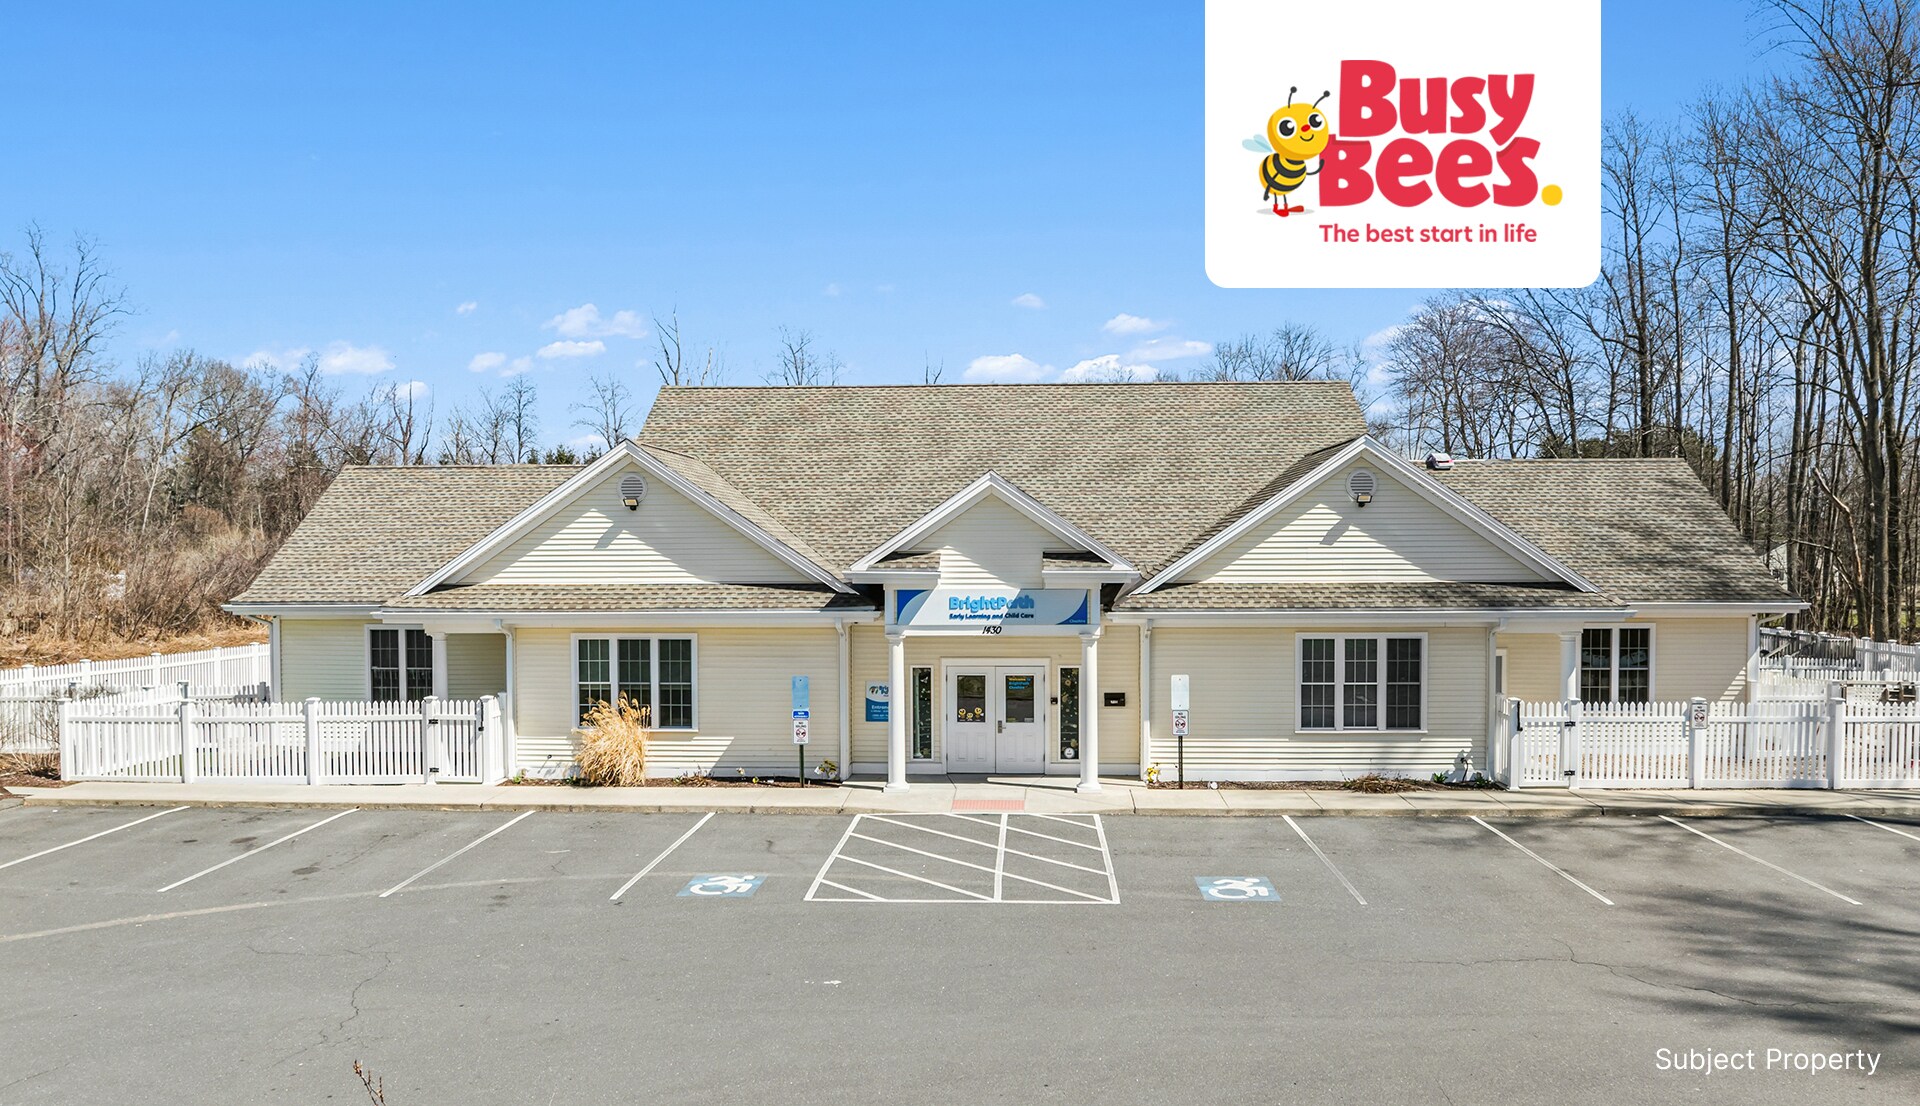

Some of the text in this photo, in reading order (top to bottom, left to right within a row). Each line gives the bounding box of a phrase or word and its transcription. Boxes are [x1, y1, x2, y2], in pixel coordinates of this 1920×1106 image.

[948, 595, 1035, 613] BrightPath
[949, 613, 965, 621] Early
[966, 613, 991, 621] Learning
[982, 625, 1002, 635] 1430
